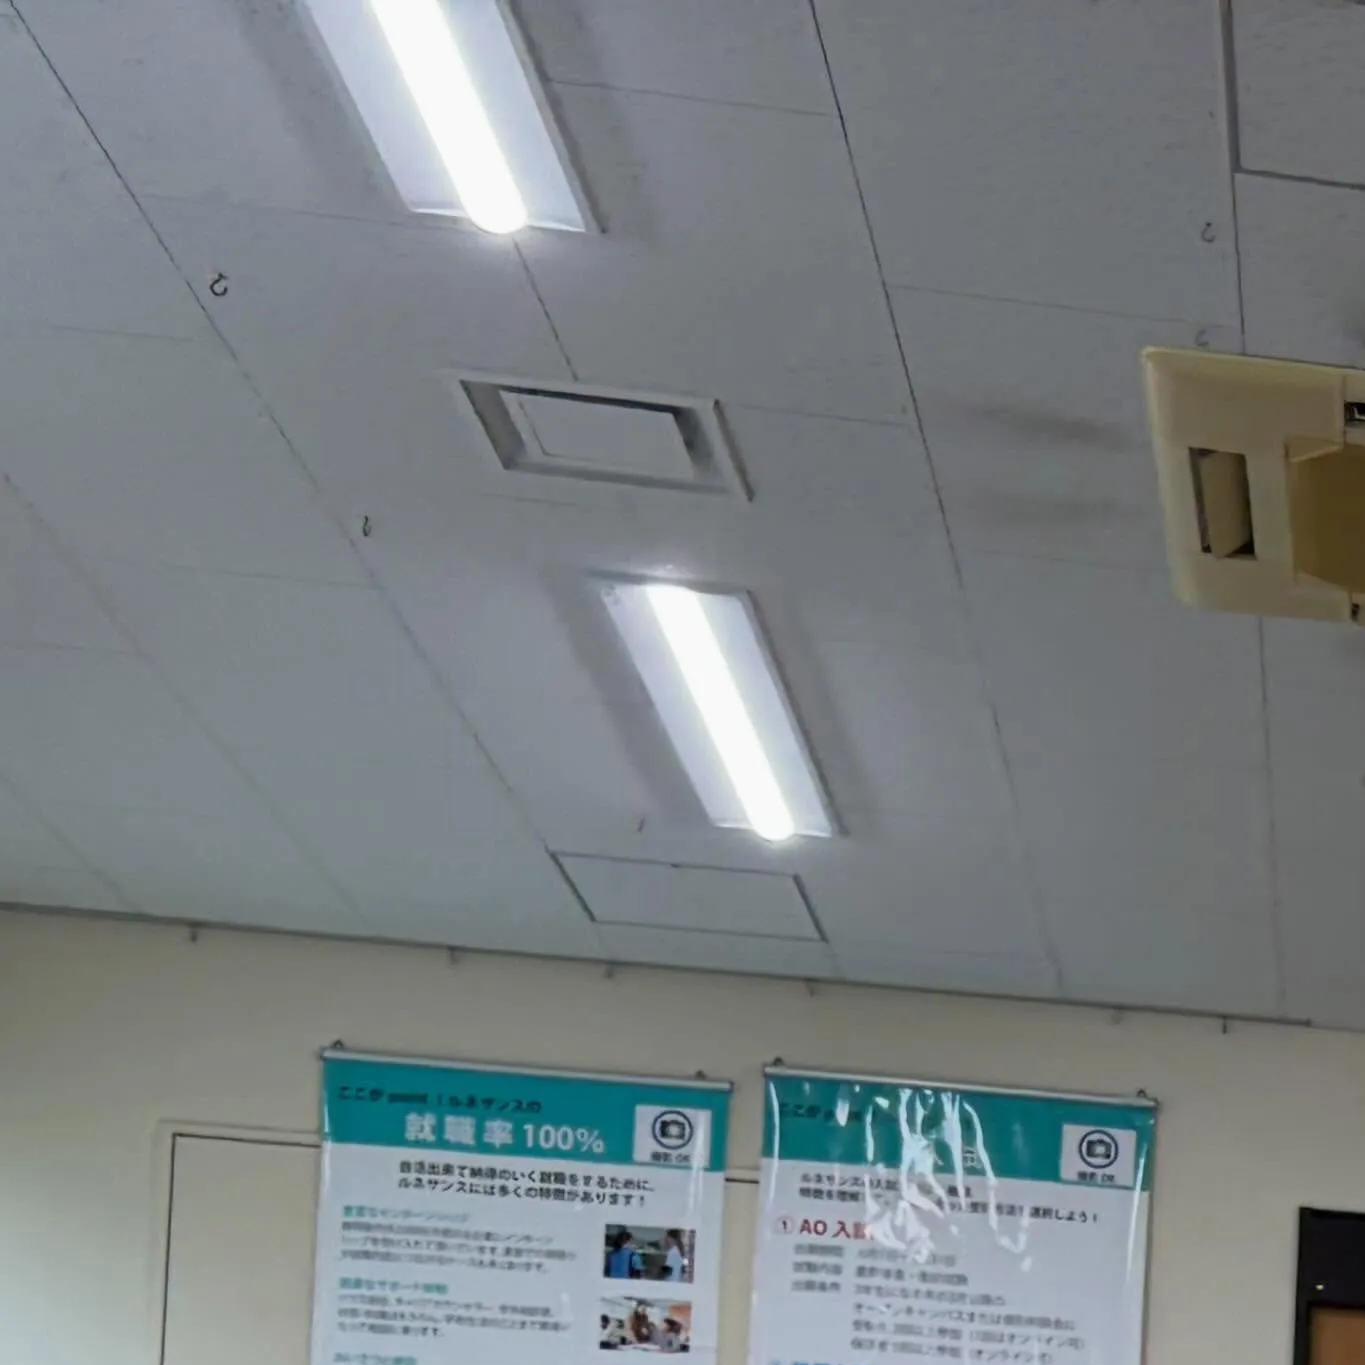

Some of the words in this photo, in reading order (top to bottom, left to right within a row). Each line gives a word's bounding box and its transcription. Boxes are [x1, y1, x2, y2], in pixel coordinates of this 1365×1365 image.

[403, 1111, 514, 1149] 就職率
[522, 1123, 606, 1154] 100%
[800, 1218, 828, 1236] AO
